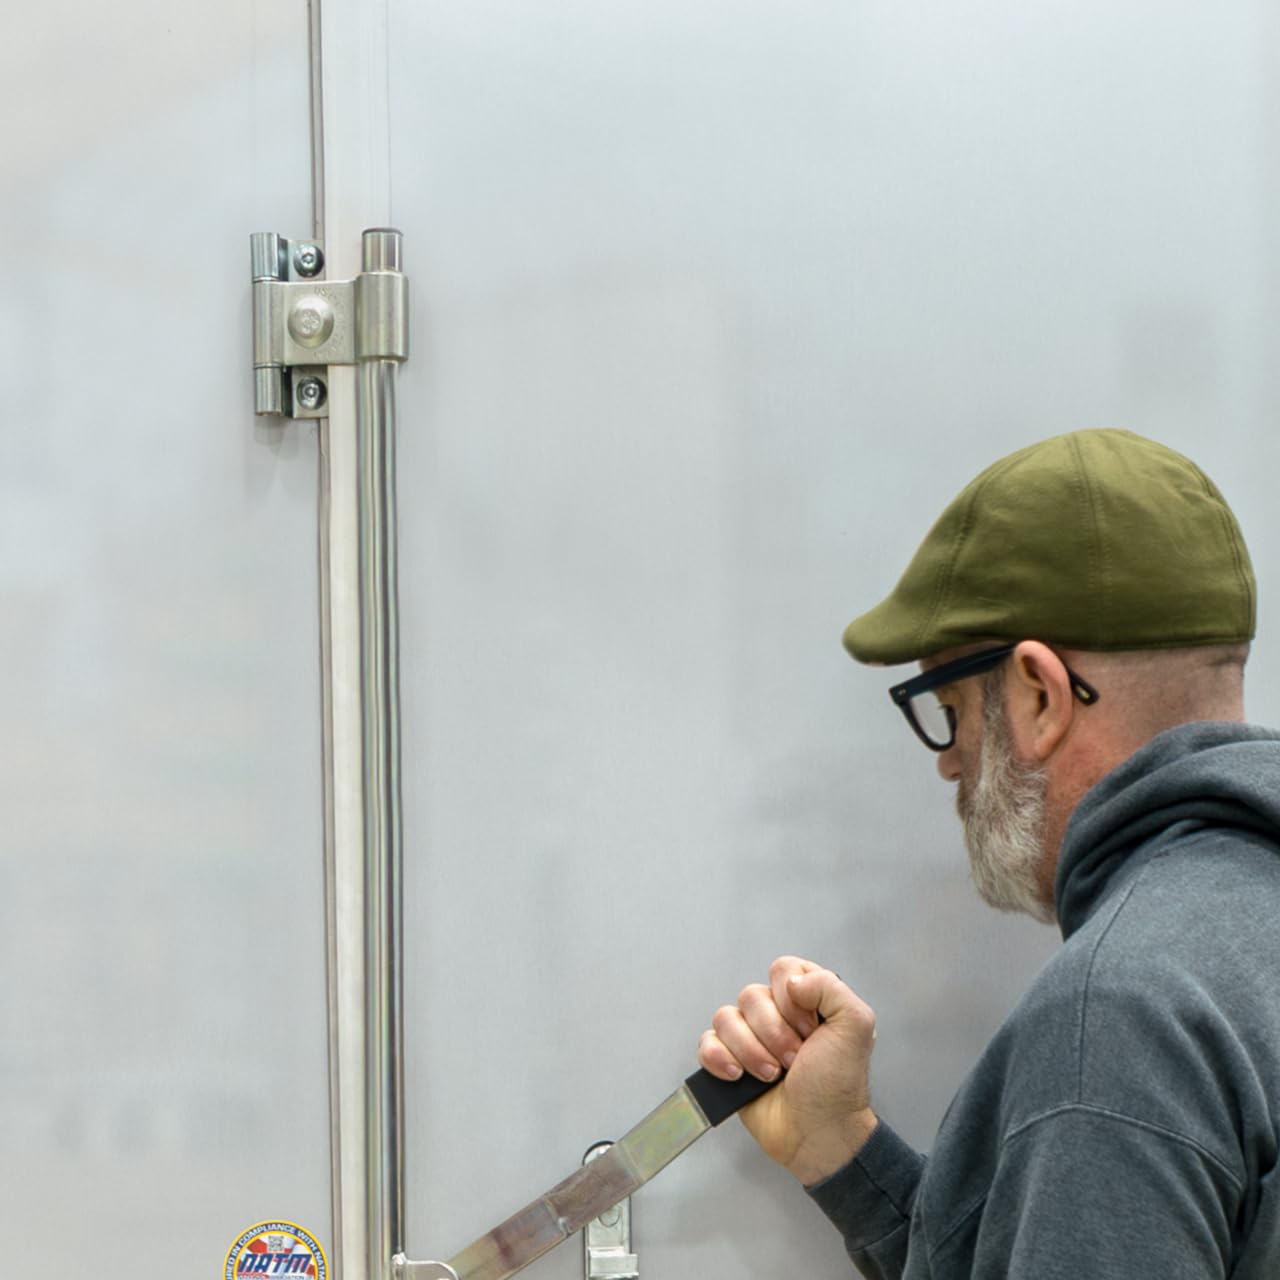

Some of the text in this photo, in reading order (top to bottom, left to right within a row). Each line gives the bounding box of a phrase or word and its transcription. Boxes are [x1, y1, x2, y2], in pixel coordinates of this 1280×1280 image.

[232, 1247, 240, 1257] IN
[239, 1224, 296, 1246] COMPLIANCE
[297, 1231, 316, 1251] WITH
[315, 1250, 325, 1279] NATM
[238, 1253, 312, 1273] NATM
